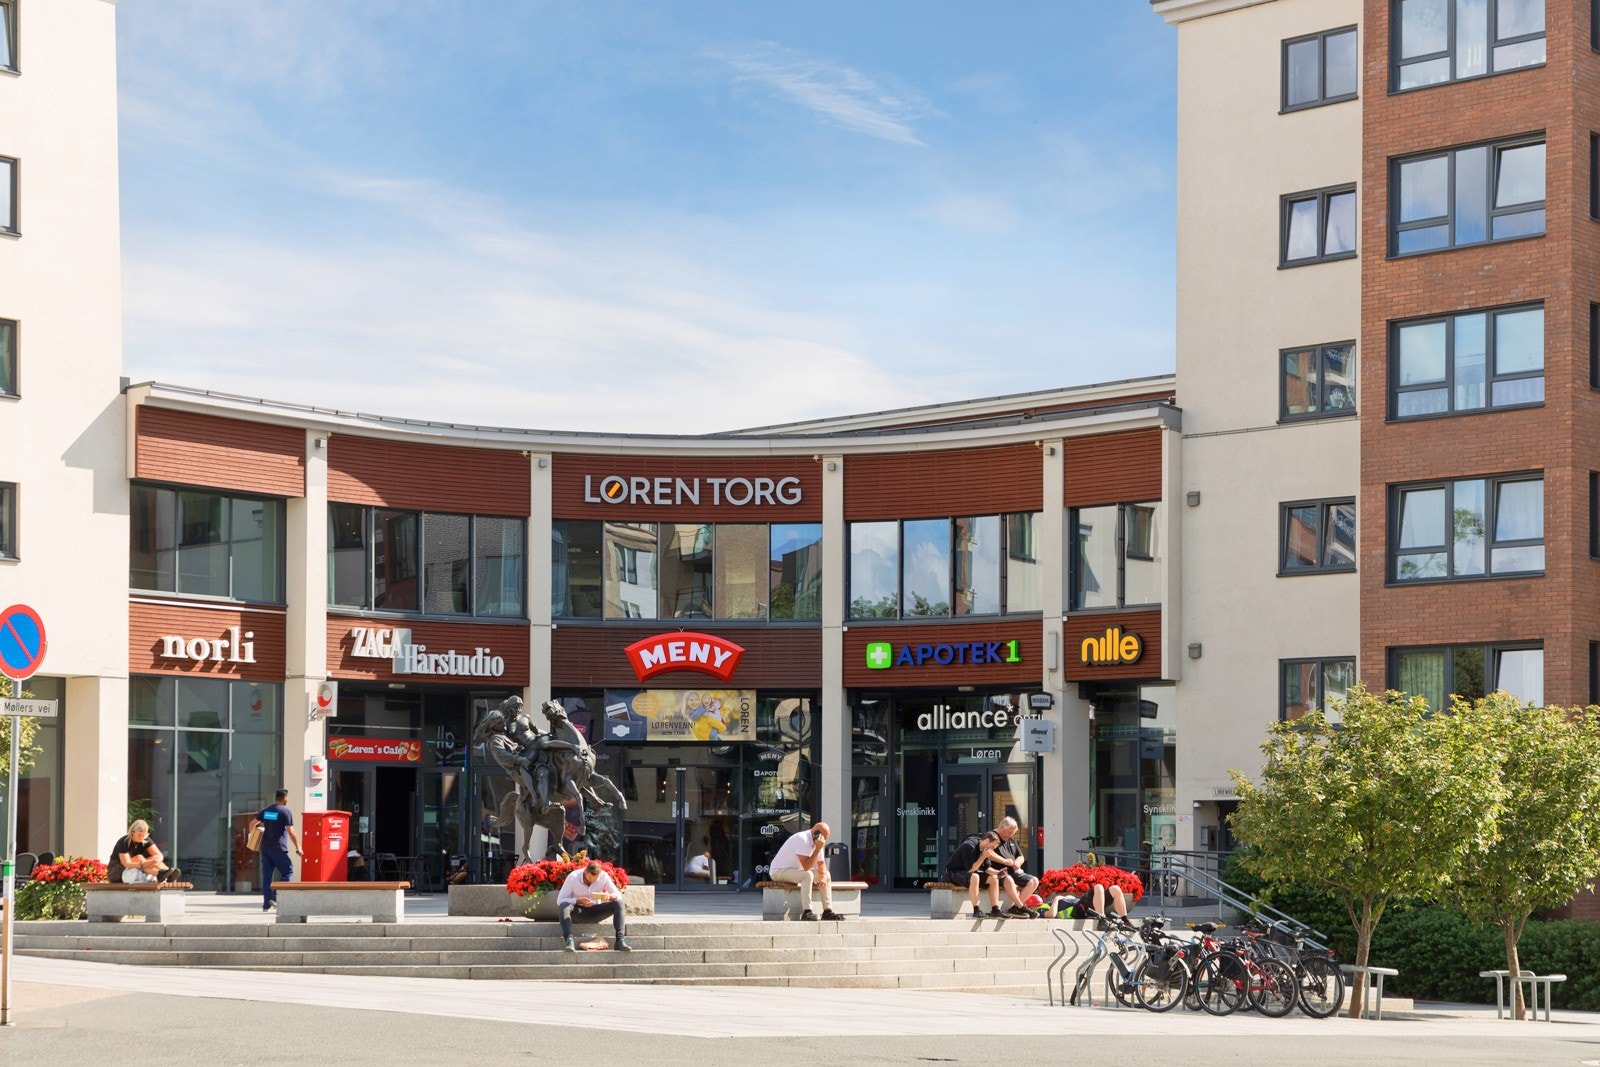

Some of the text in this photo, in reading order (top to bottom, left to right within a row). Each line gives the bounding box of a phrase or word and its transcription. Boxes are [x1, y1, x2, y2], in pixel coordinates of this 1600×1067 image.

[585, 475, 801, 506] LØREN TORG
[160, 625, 257, 663] norli
[351, 627, 504, 677] ZAGA Hårstudio
[639, 641, 733, 669] MENY
[896, 640, 1022, 666] APOTEK 1
[1081, 627, 1139, 662] nille
[4, 702, 51, 713] Møllers vei
[651, 721, 696, 730] LØRENVENN!
[971, 747, 1002, 759] Løren
[896, 807, 936, 818] Synsklinikk
